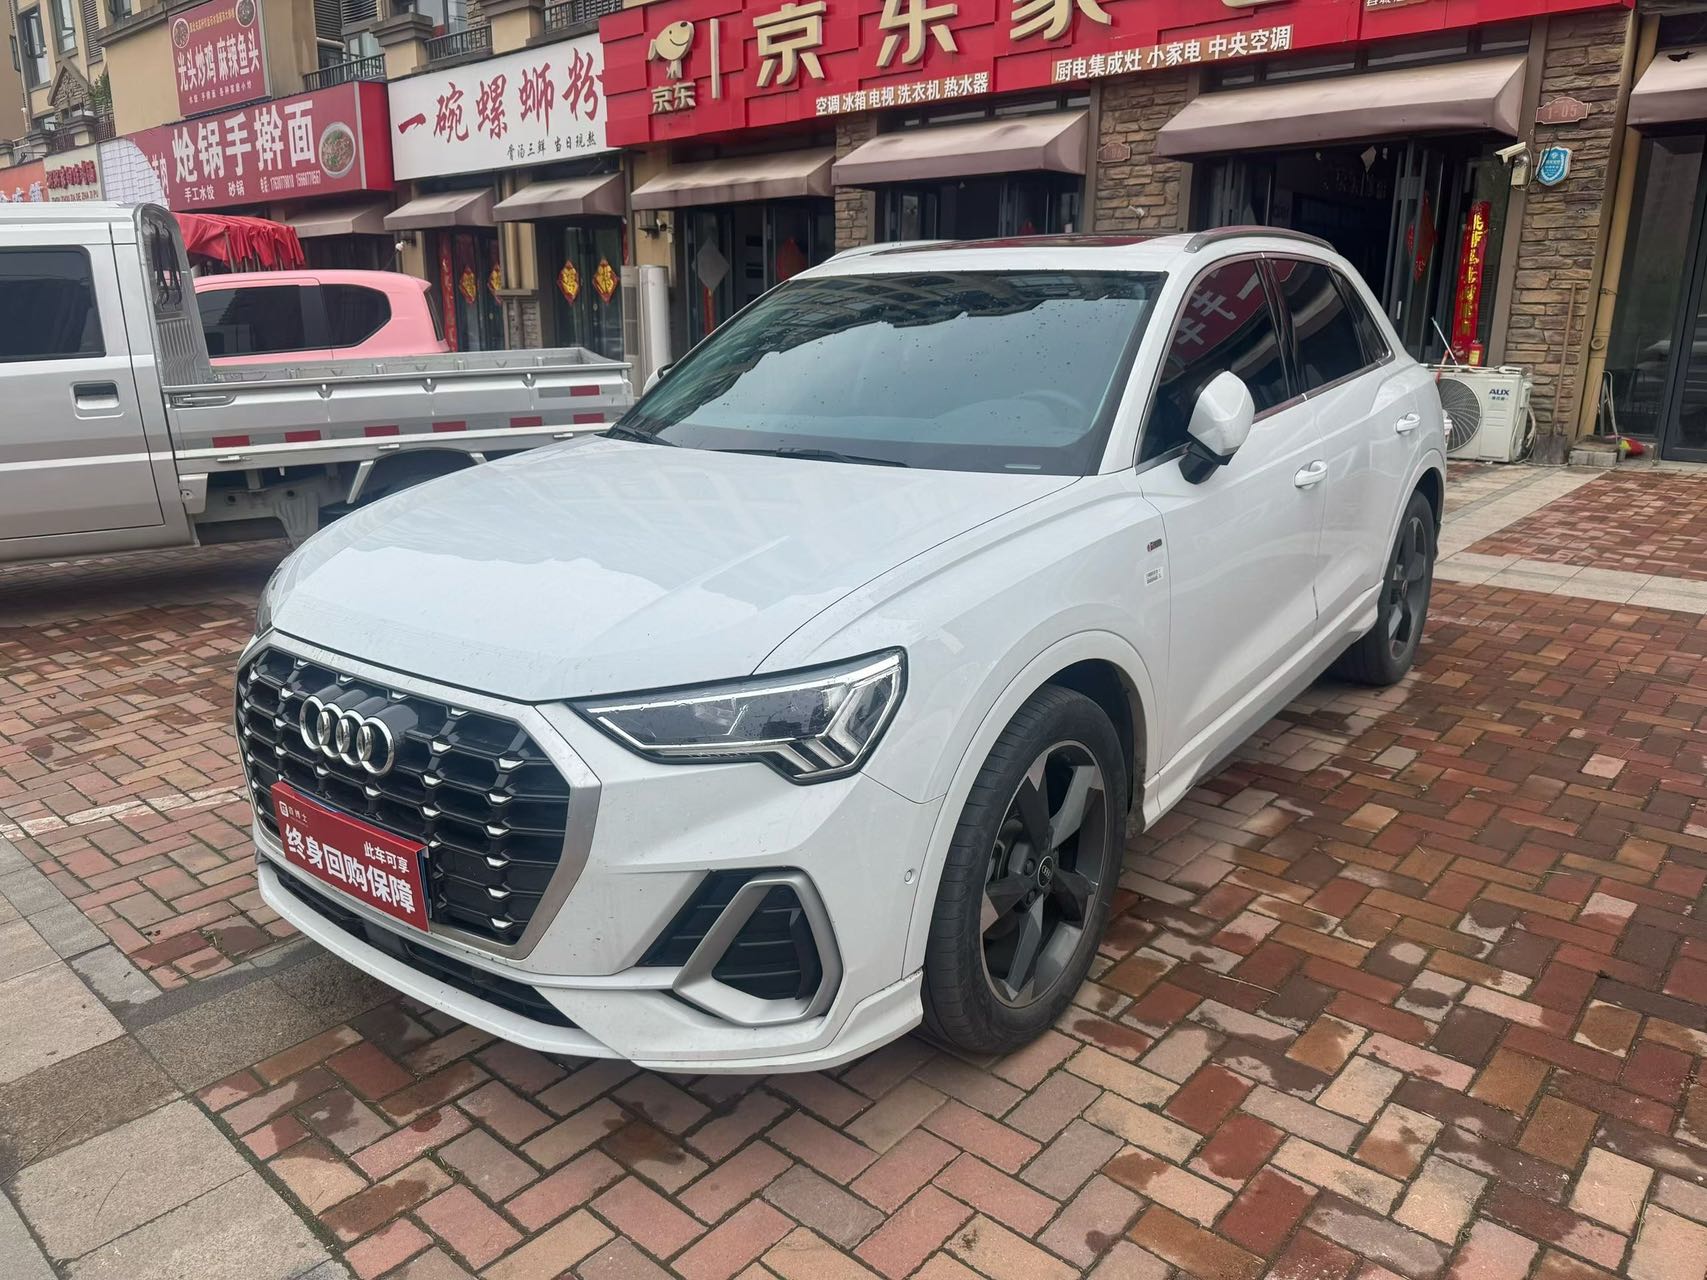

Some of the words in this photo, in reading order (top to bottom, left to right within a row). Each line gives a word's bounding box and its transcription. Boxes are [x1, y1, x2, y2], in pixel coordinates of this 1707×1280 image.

[178, 41, 217, 92] 光头炒鸡
[217, 28, 260, 80] 麻辣鱼头
[1054, 51, 1142, 82] 厨电集成灶
[1147, 39, 1202, 68] 小家电
[1208, 27, 1290, 59] 中央空调
[398, 48, 604, 144] 一碗螺蛳粉
[651, 82, 697, 113] 京东
[815, 96, 840, 116] 空调
[842, 90, 867, 112] 冰箱
[869, 84, 895, 106] 电视
[897, 80, 941, 104] 洗衣机
[944, 72, 990, 98] 热水器
[172, 100, 316, 183] 炝锅手擀面
[184, 185, 215, 203] 手工水饺
[228, 180, 245, 197] 砂锅
[285, 823, 416, 914] 终身回购保障
[364, 841, 409, 874] 此车可享
